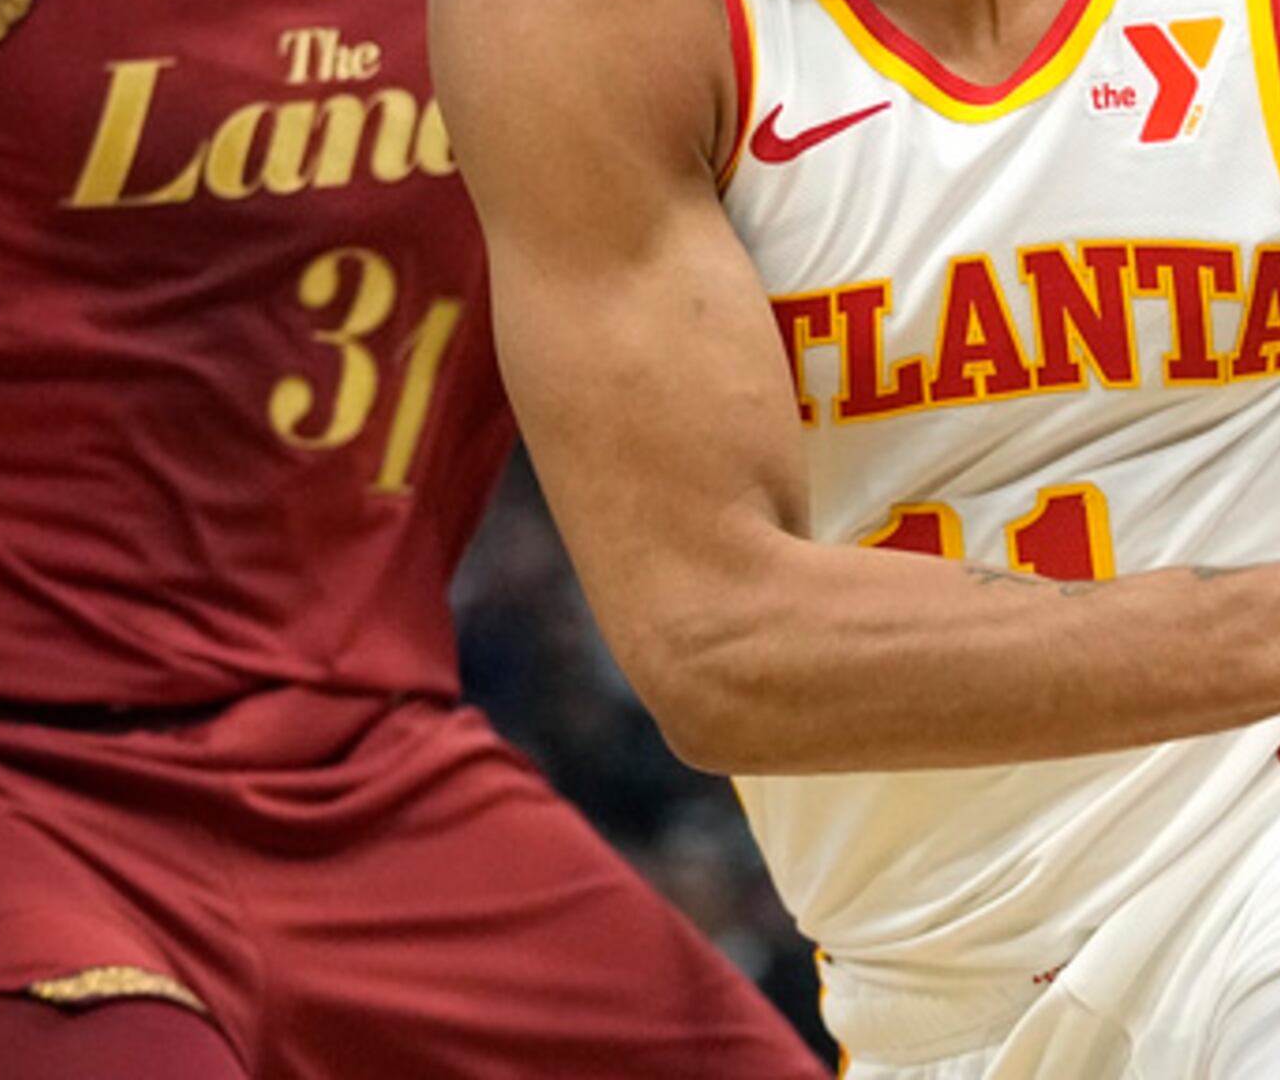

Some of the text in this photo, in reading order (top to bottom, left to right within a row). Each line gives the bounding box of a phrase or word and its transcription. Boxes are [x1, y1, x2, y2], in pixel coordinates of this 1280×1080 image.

[280, 28, 381, 84] The
[1090, 82, 1136, 110] the
[268, 246, 464, 497] 31
